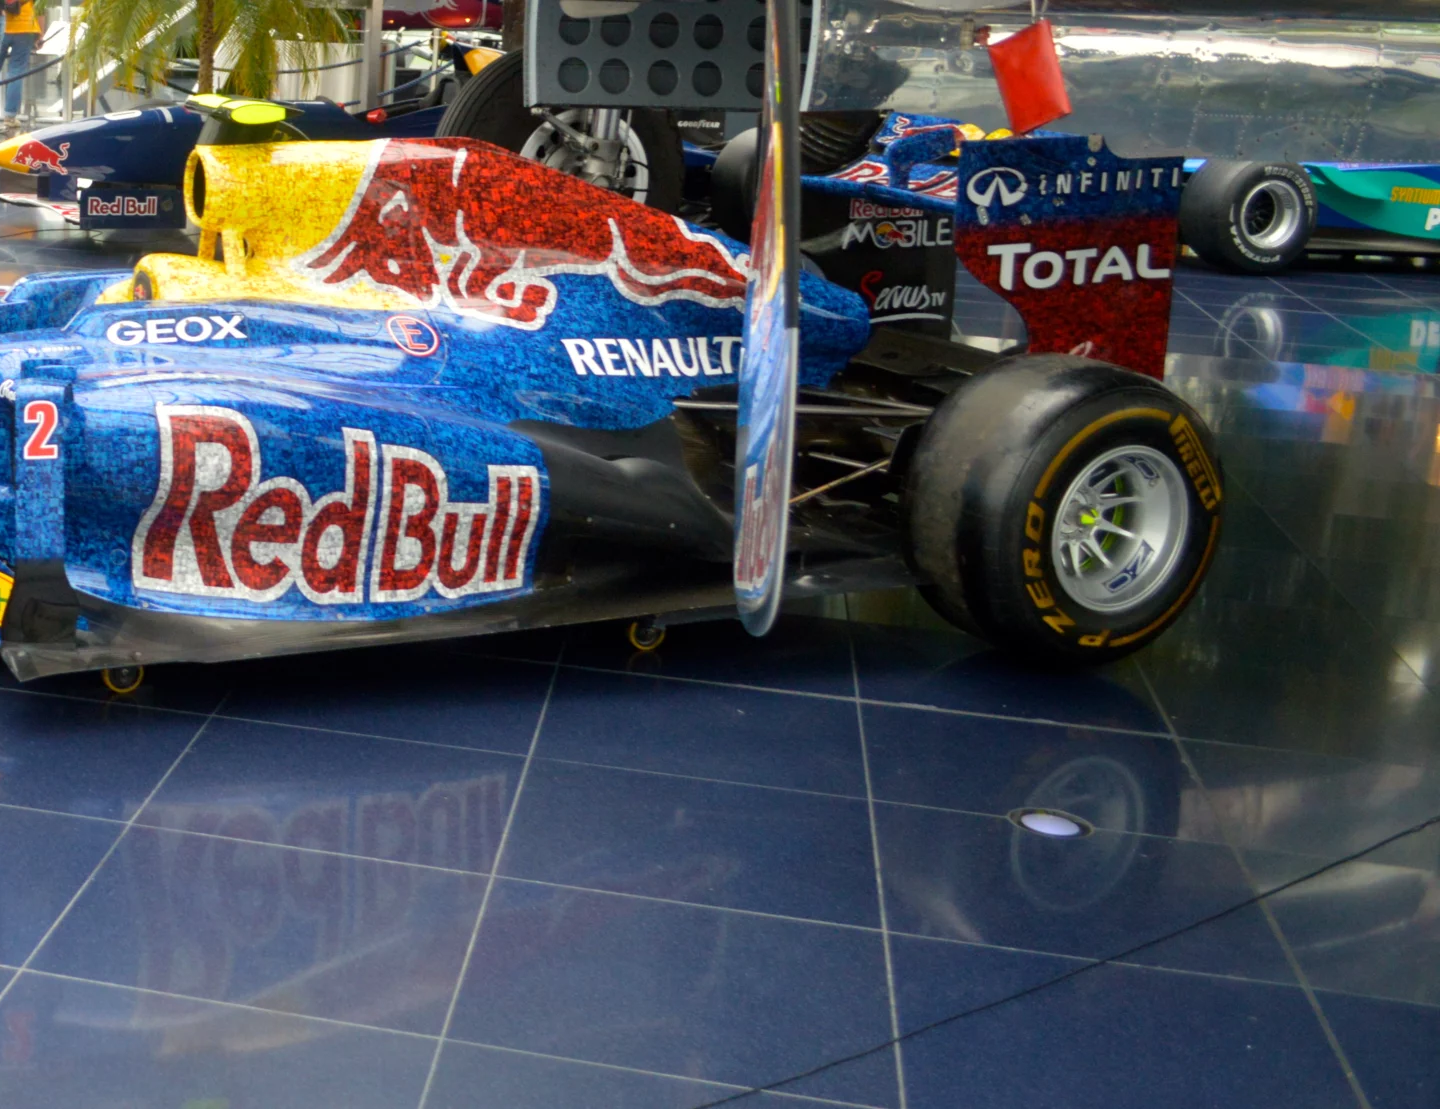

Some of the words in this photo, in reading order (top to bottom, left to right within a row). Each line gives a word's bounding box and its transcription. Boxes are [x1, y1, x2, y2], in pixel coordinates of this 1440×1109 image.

[1039, 167, 1179, 195] INFINITI
[87, 196, 122, 216] Red
[124, 195, 158, 216] Bull
[987, 242, 1171, 291] TOTAL
[106, 314, 247, 346] GEOX
[560, 336, 742, 377] RENAULT
[23, 399, 58, 460] 2
[132, 401, 378, 604] Red
[371, 443, 542, 601] Bull
[1023, 501, 1075, 633] ZERO
